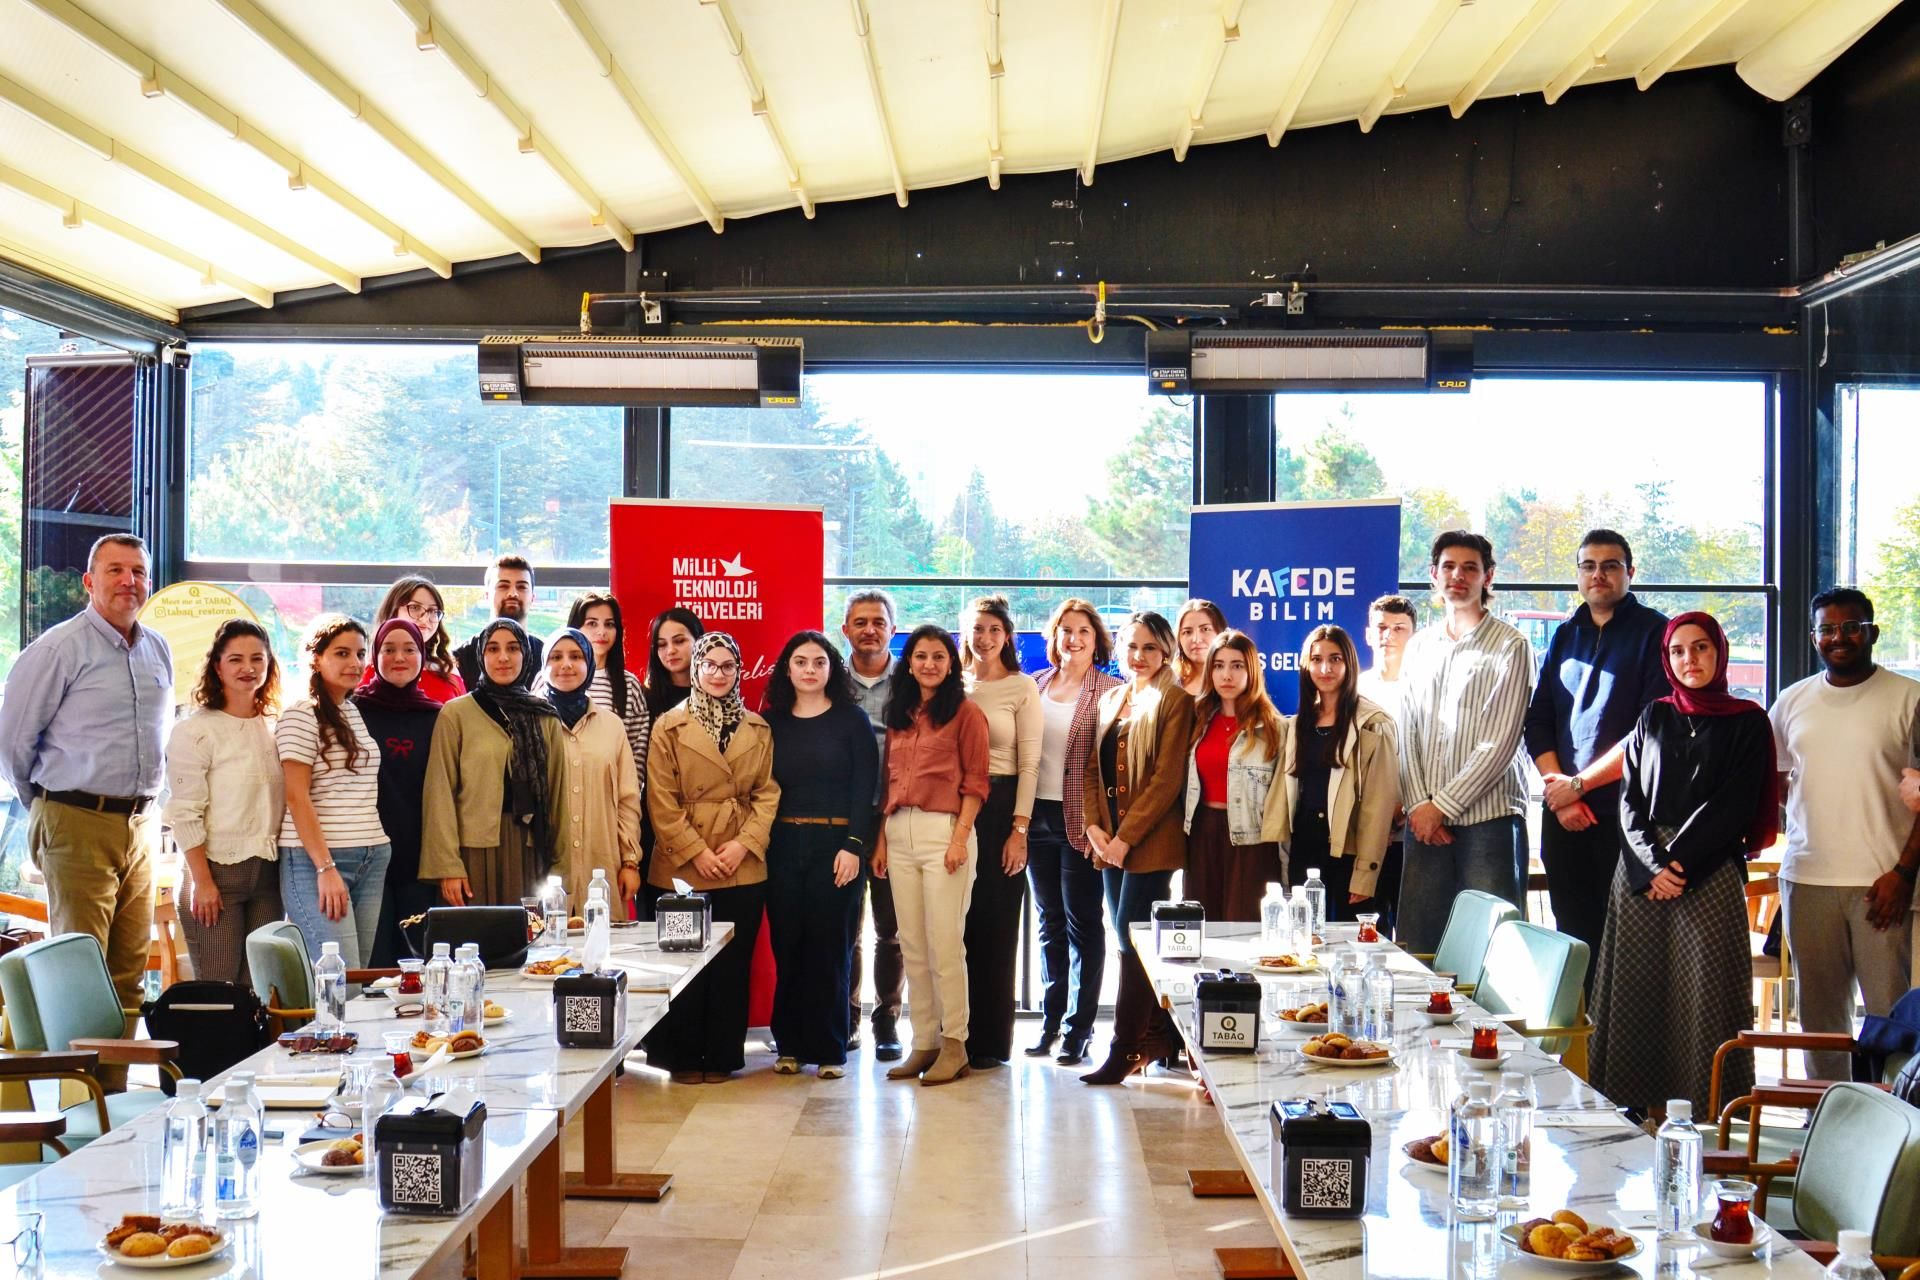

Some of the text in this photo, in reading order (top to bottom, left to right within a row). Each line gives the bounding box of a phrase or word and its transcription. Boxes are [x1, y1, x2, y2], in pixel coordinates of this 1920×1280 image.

[672, 579, 758, 599] TEKNOLOJİ
[1232, 566, 1356, 599] KAFEDE
[1250, 601, 1335, 621] BİLİM
[1212, 1032, 1245, 1041] TABAQ
